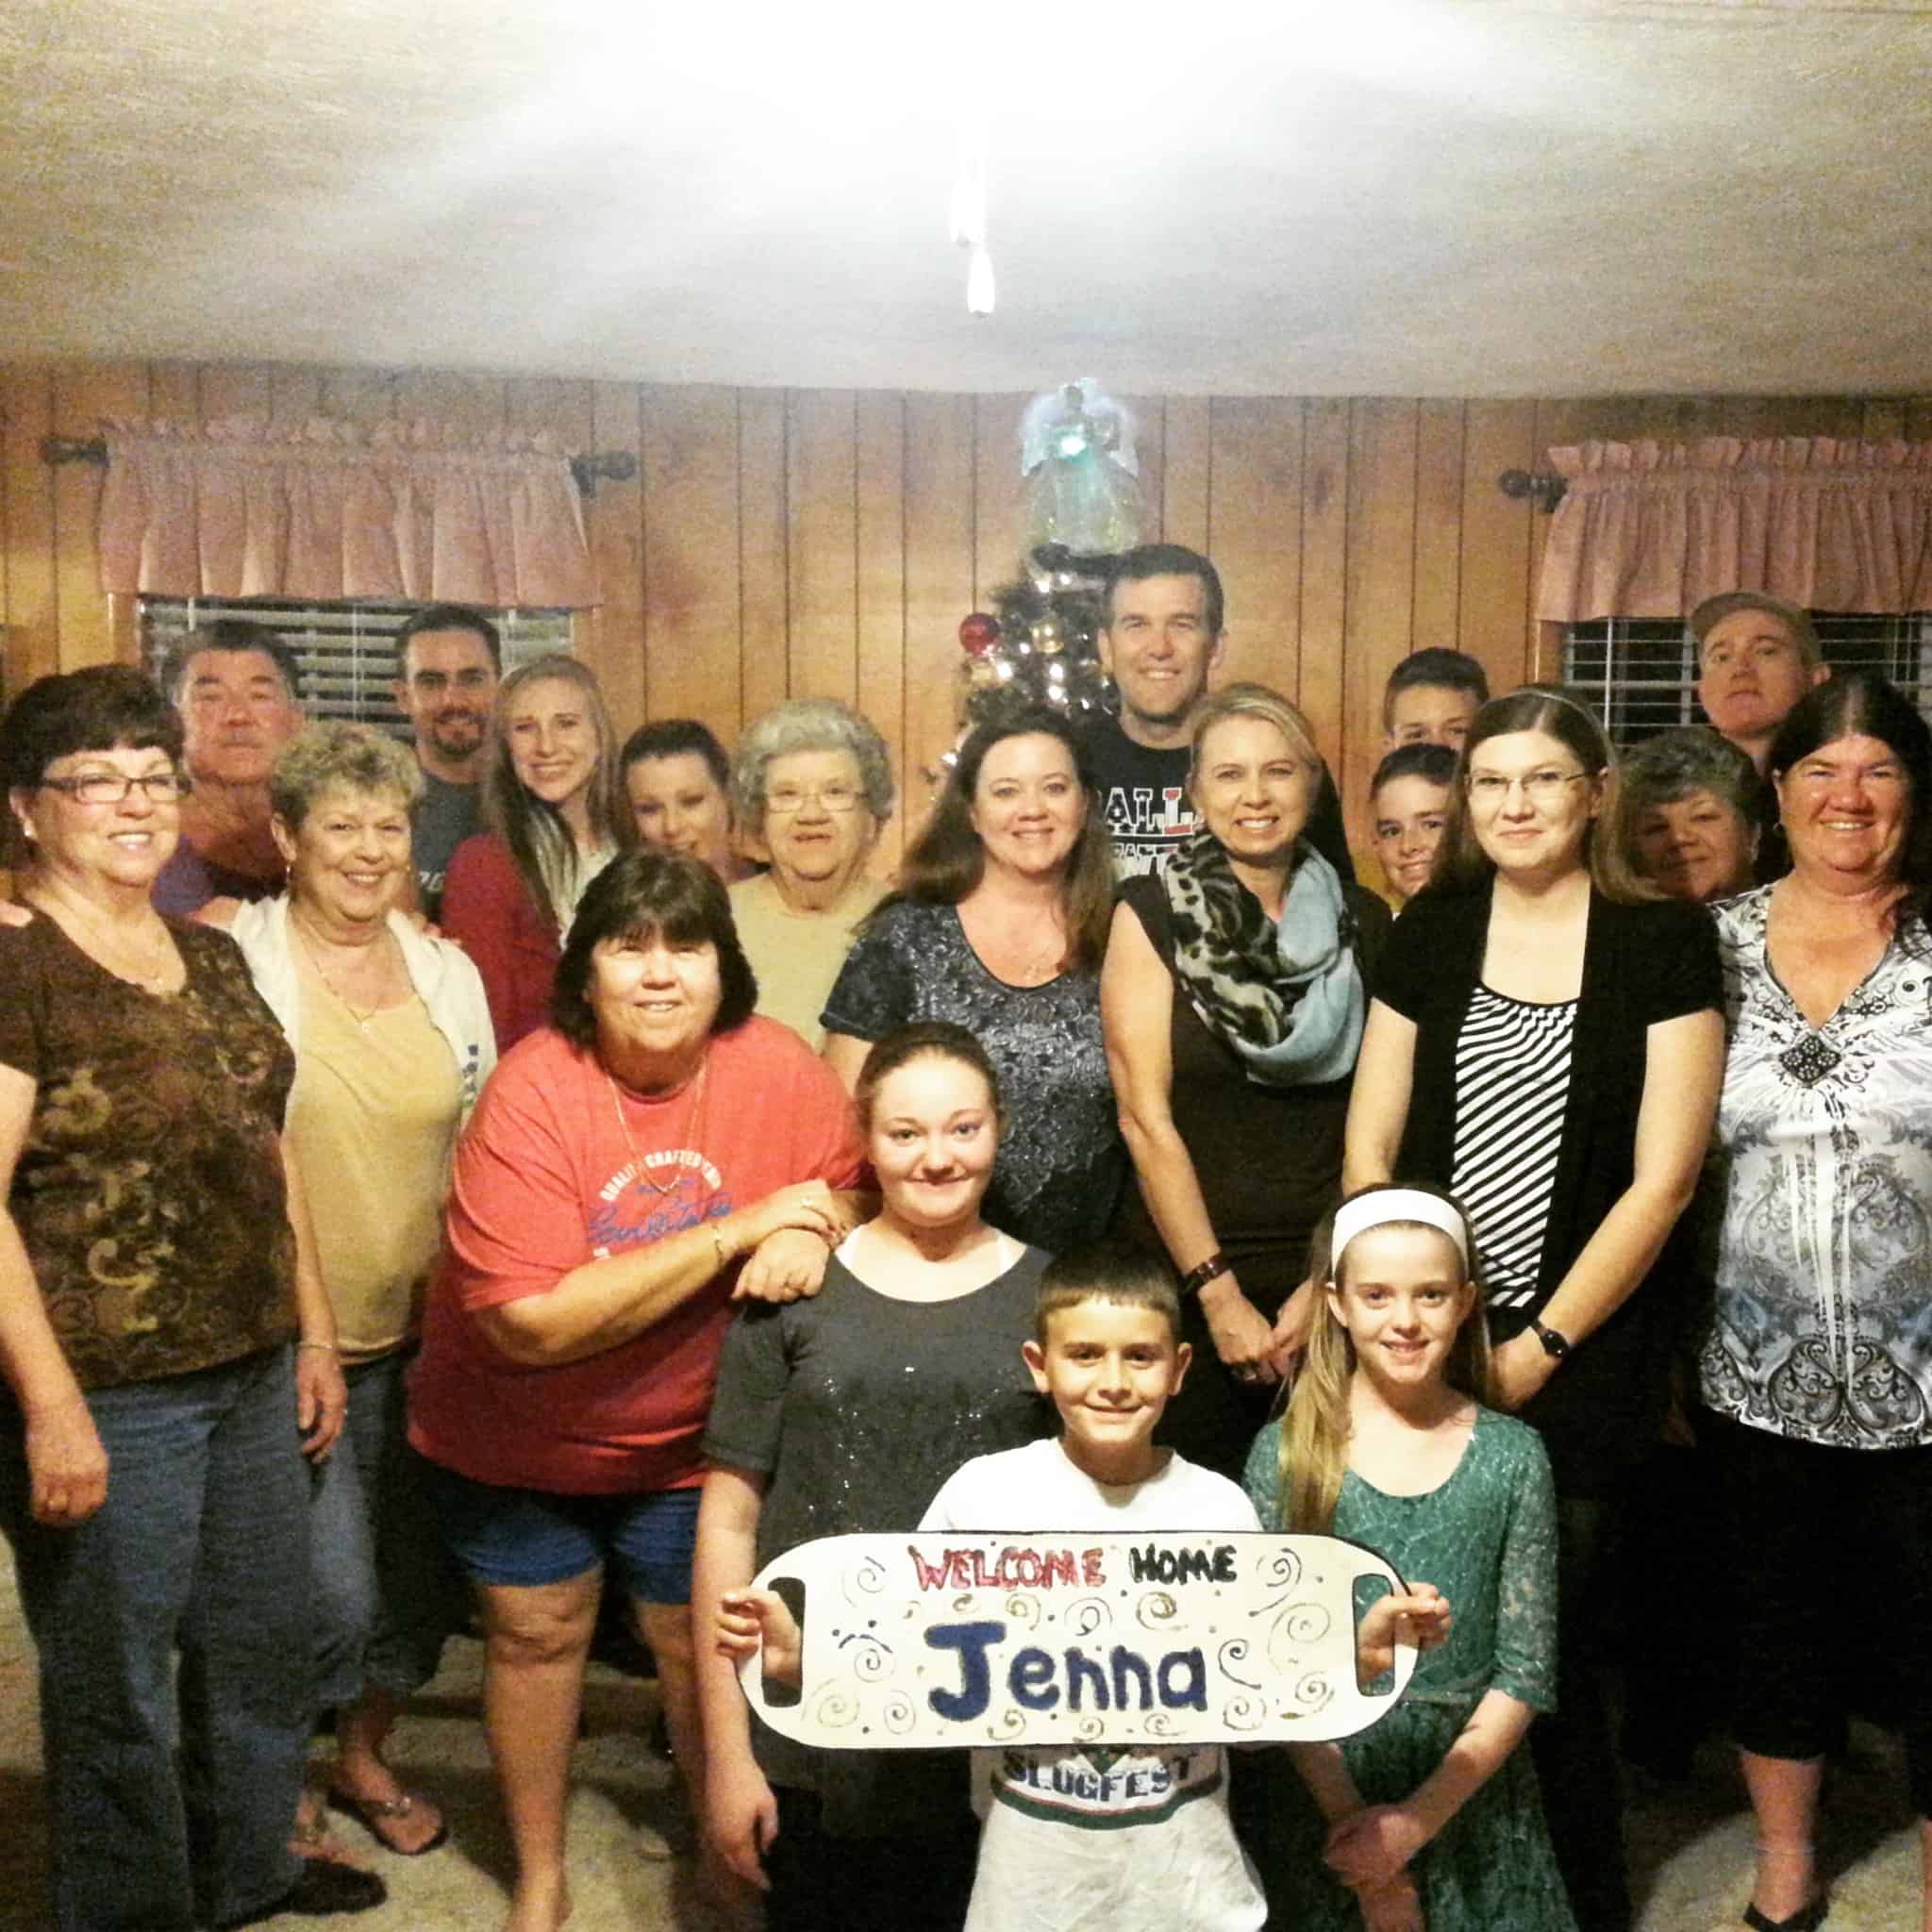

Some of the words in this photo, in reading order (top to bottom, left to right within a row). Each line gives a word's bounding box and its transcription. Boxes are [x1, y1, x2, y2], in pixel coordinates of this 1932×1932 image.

[908, 1545, 1107, 1591] WELCOME
[1129, 1543, 1238, 1585] HOME
[924, 1620, 1208, 1723] Jenna
[1002, 1750, 1197, 1803] SLUGFEST
